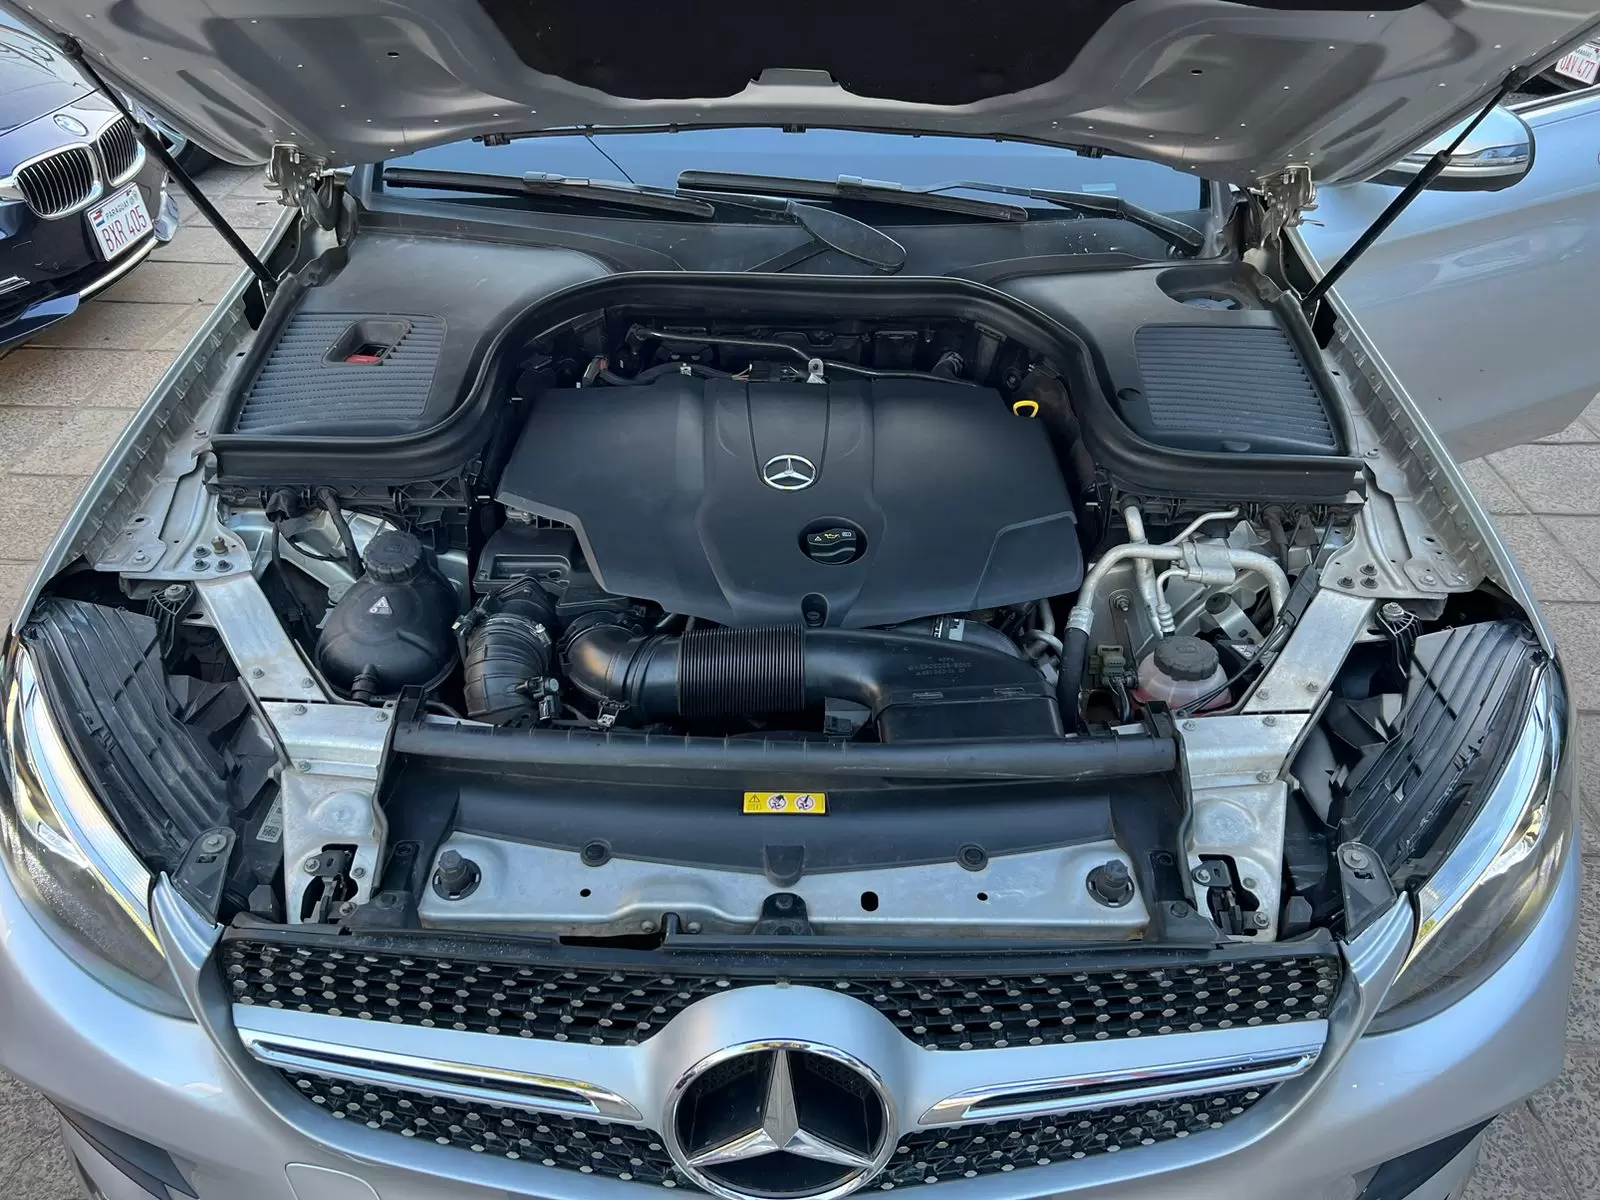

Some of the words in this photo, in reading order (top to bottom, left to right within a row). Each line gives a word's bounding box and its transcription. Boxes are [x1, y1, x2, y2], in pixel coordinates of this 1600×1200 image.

[1577, 59, 1596, 79] 477
[105, 200, 130, 218] PARAGUAY
[102, 220, 128, 252] BXR
[125, 205, 147, 235] 405
